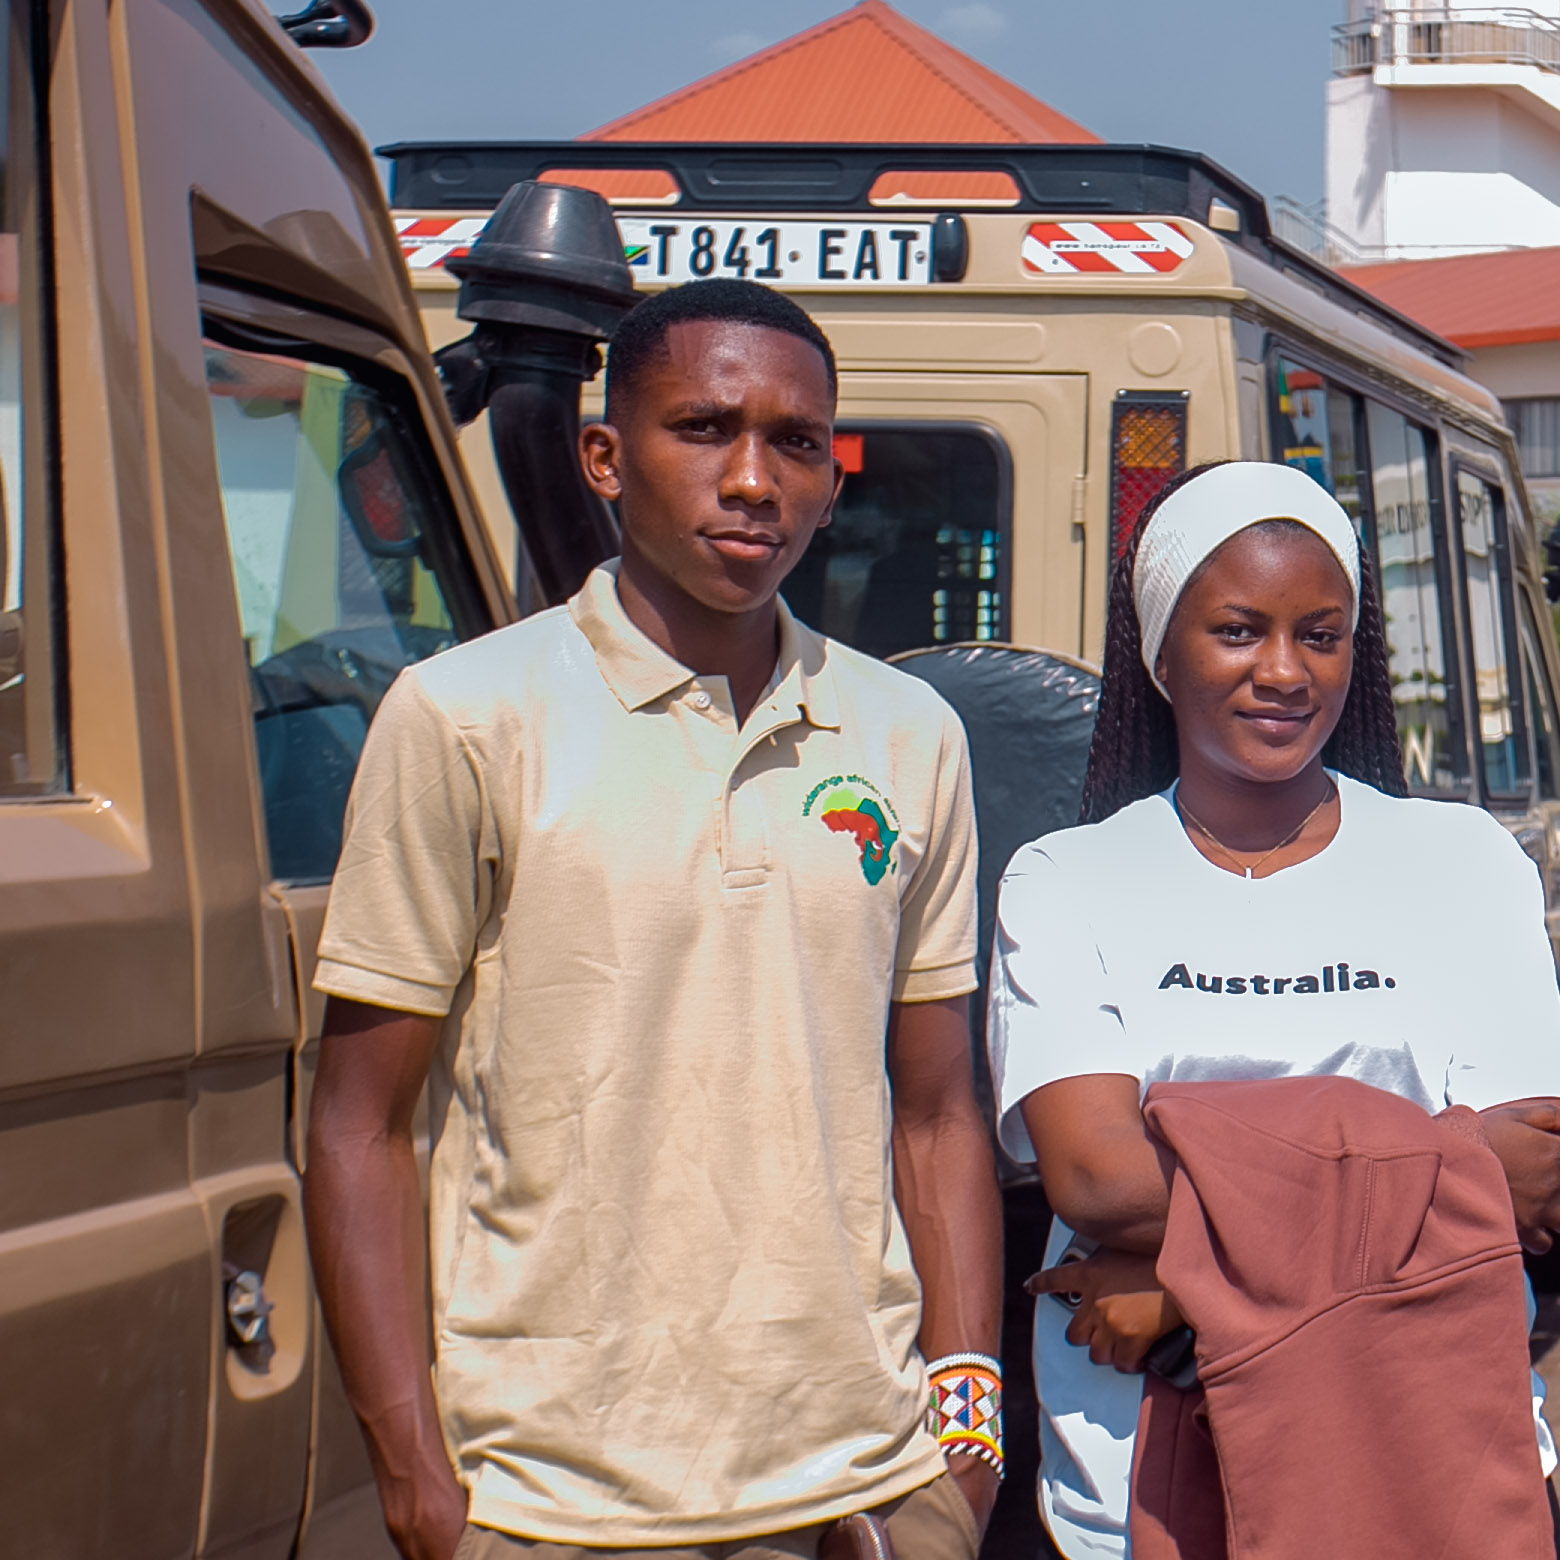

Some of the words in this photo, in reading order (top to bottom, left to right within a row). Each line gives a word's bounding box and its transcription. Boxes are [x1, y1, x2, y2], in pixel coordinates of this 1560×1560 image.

[650, 225, 679, 276] T
[689, 226, 783, 279] 841
[818, 228, 919, 280] EAT
[1158, 963, 1396, 995] Australia.
